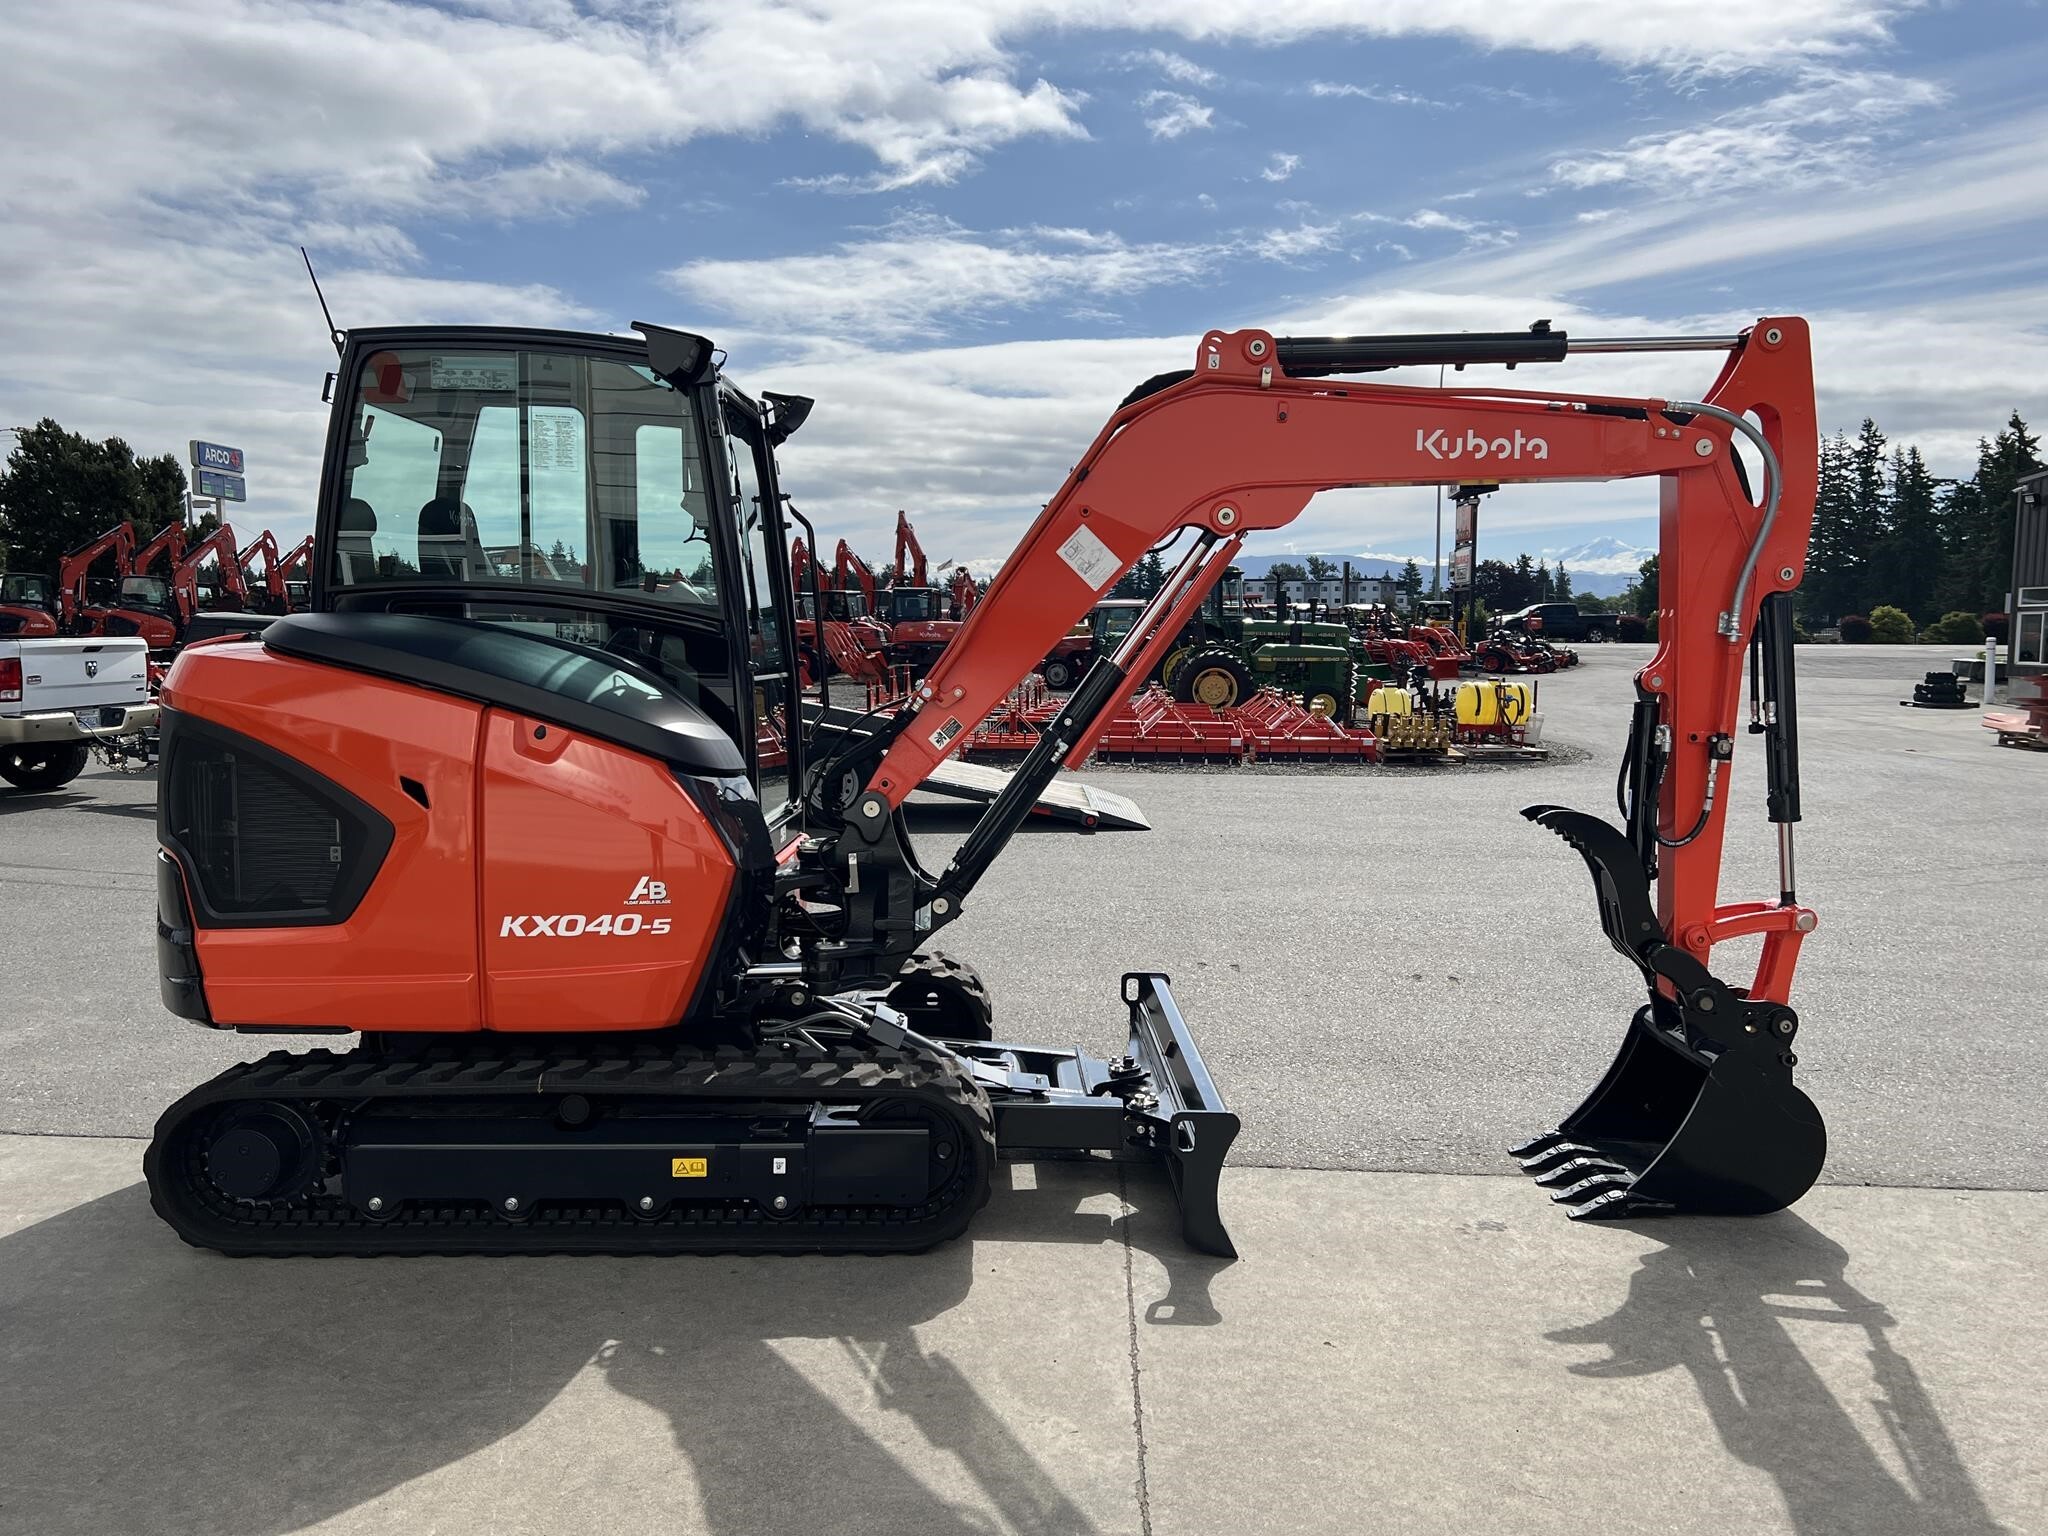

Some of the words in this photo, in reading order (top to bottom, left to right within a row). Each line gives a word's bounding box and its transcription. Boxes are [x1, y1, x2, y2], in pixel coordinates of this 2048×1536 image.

[205, 447, 230, 465] ARCO
[1416, 429, 1548, 460] Kubota
[499, 914, 672, 937] KX040-5
